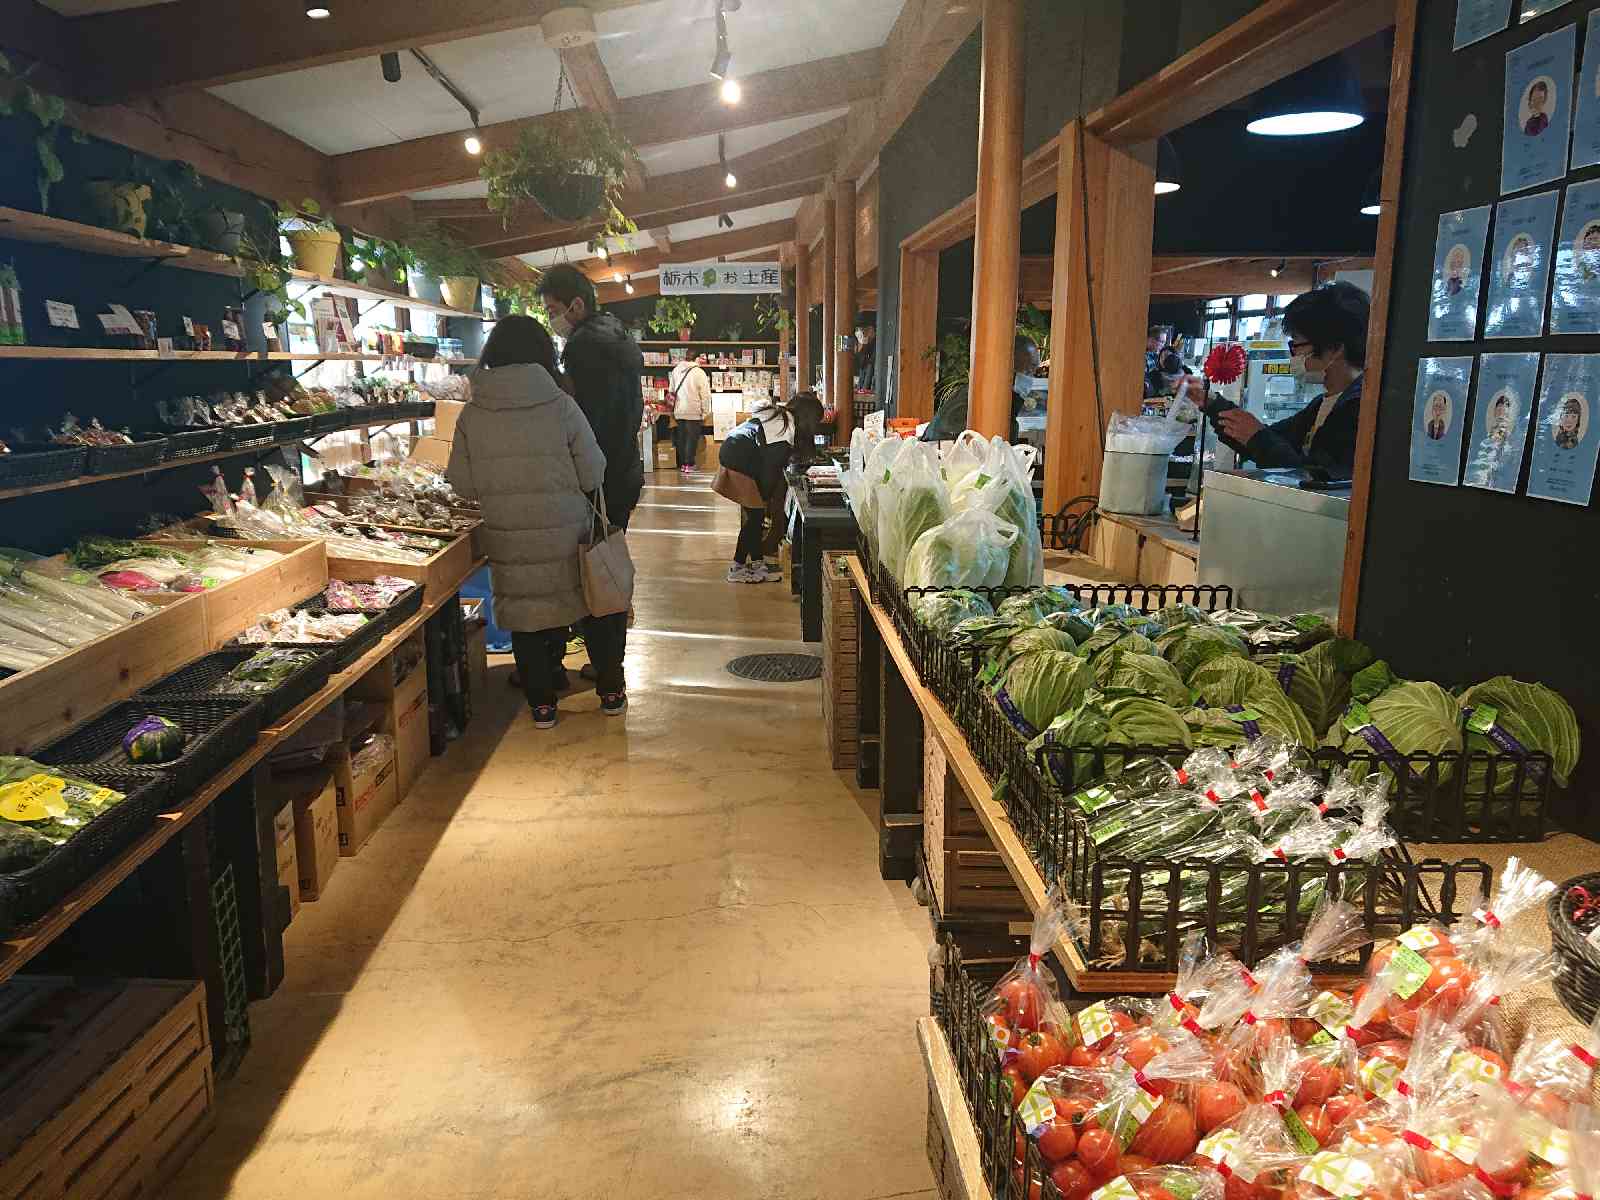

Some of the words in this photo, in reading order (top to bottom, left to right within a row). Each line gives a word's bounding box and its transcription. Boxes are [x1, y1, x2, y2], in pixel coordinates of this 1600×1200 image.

[662, 270, 699, 286] 栃木
[723, 268, 779, 285] お土産
